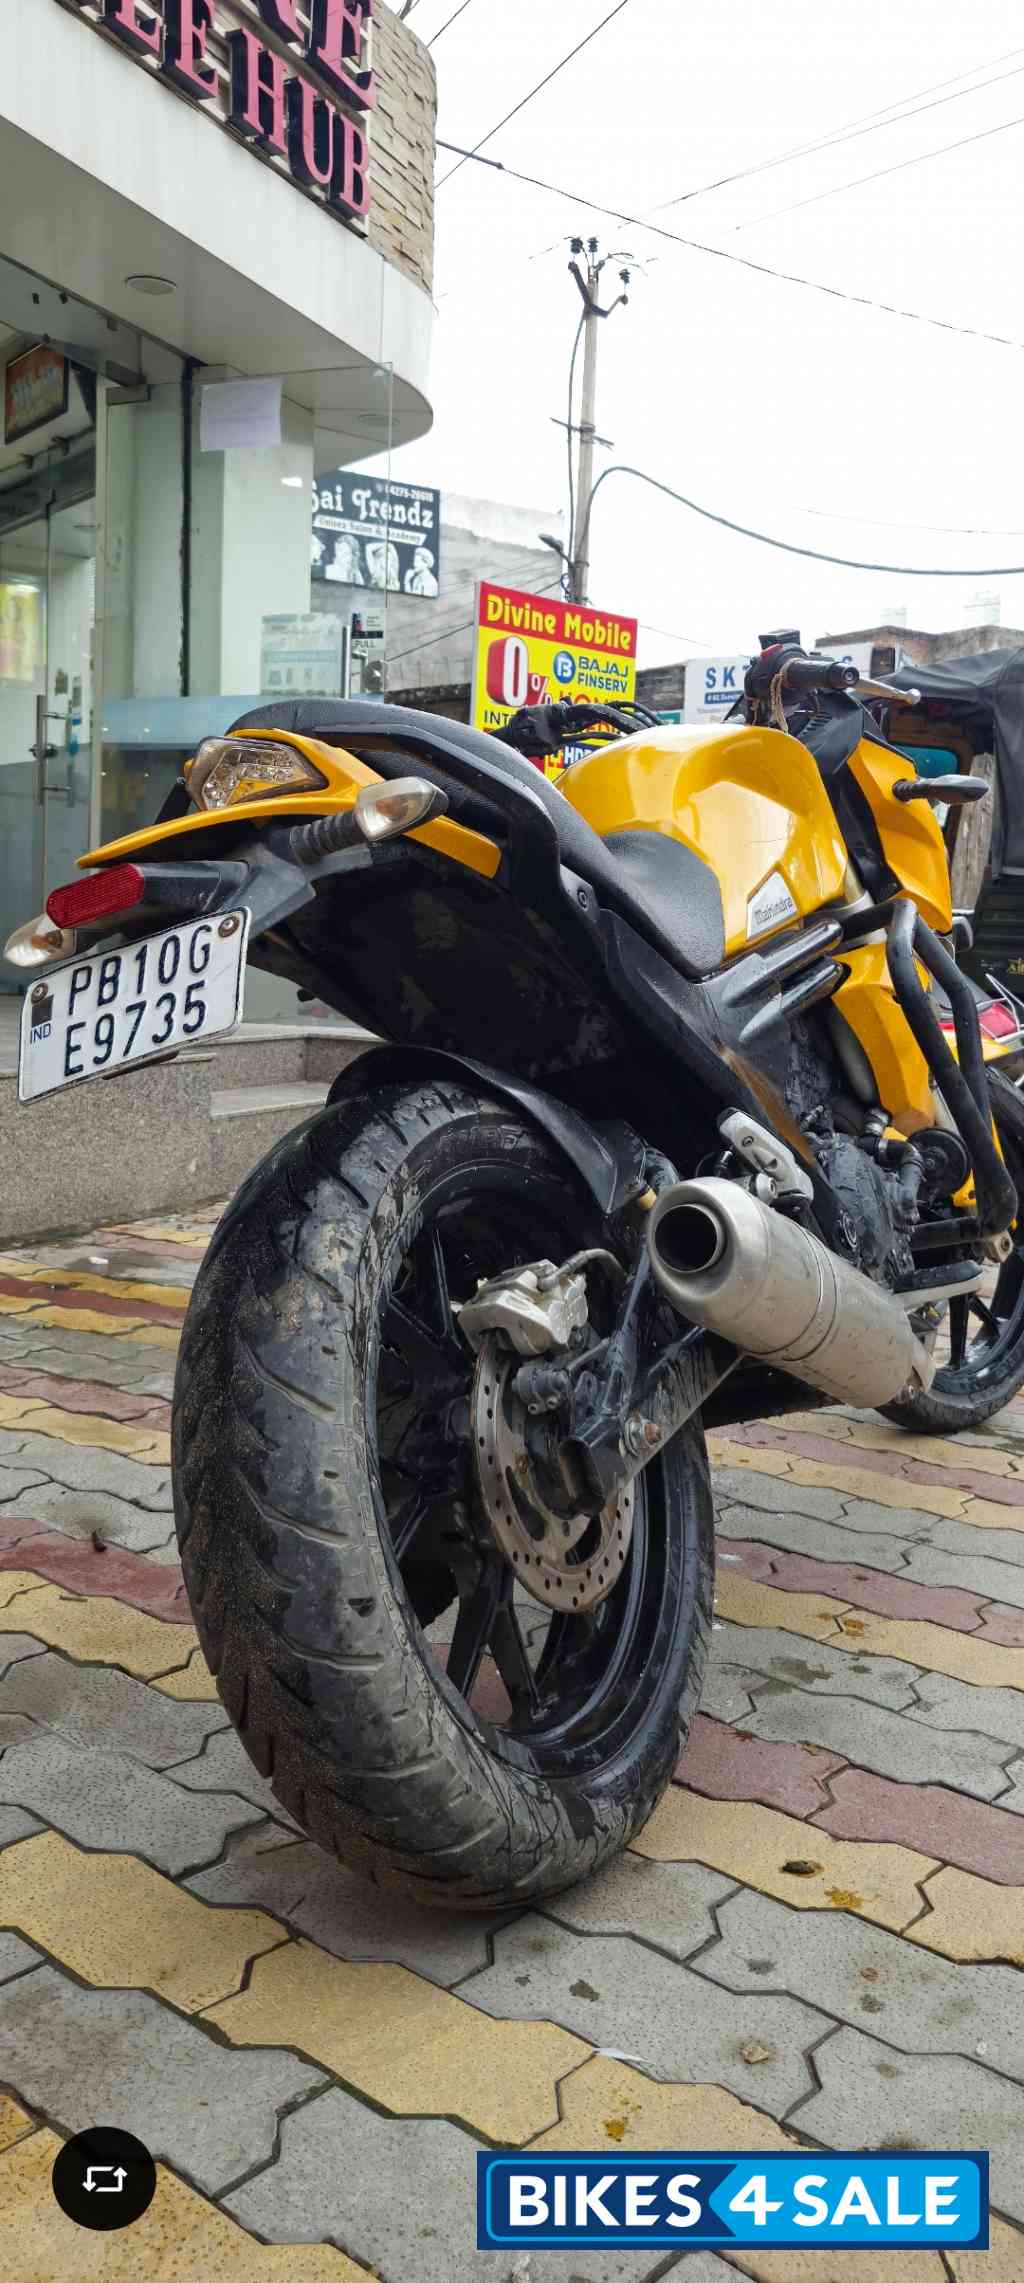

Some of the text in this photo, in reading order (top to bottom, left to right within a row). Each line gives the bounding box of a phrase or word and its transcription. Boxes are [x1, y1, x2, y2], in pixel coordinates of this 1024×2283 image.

[241, 26, 368, 215] HUB
[352, 488, 434, 529] Trendz
[487, 594, 632, 651] Divine Mobile
[577, 674, 628, 694] FINSERV
[578, 656, 629, 677] BAJAJ
[67, 924, 213, 1016] PB10G
[30, 1023, 51, 1044] IND
[63, 980, 206, 1077] E9735
